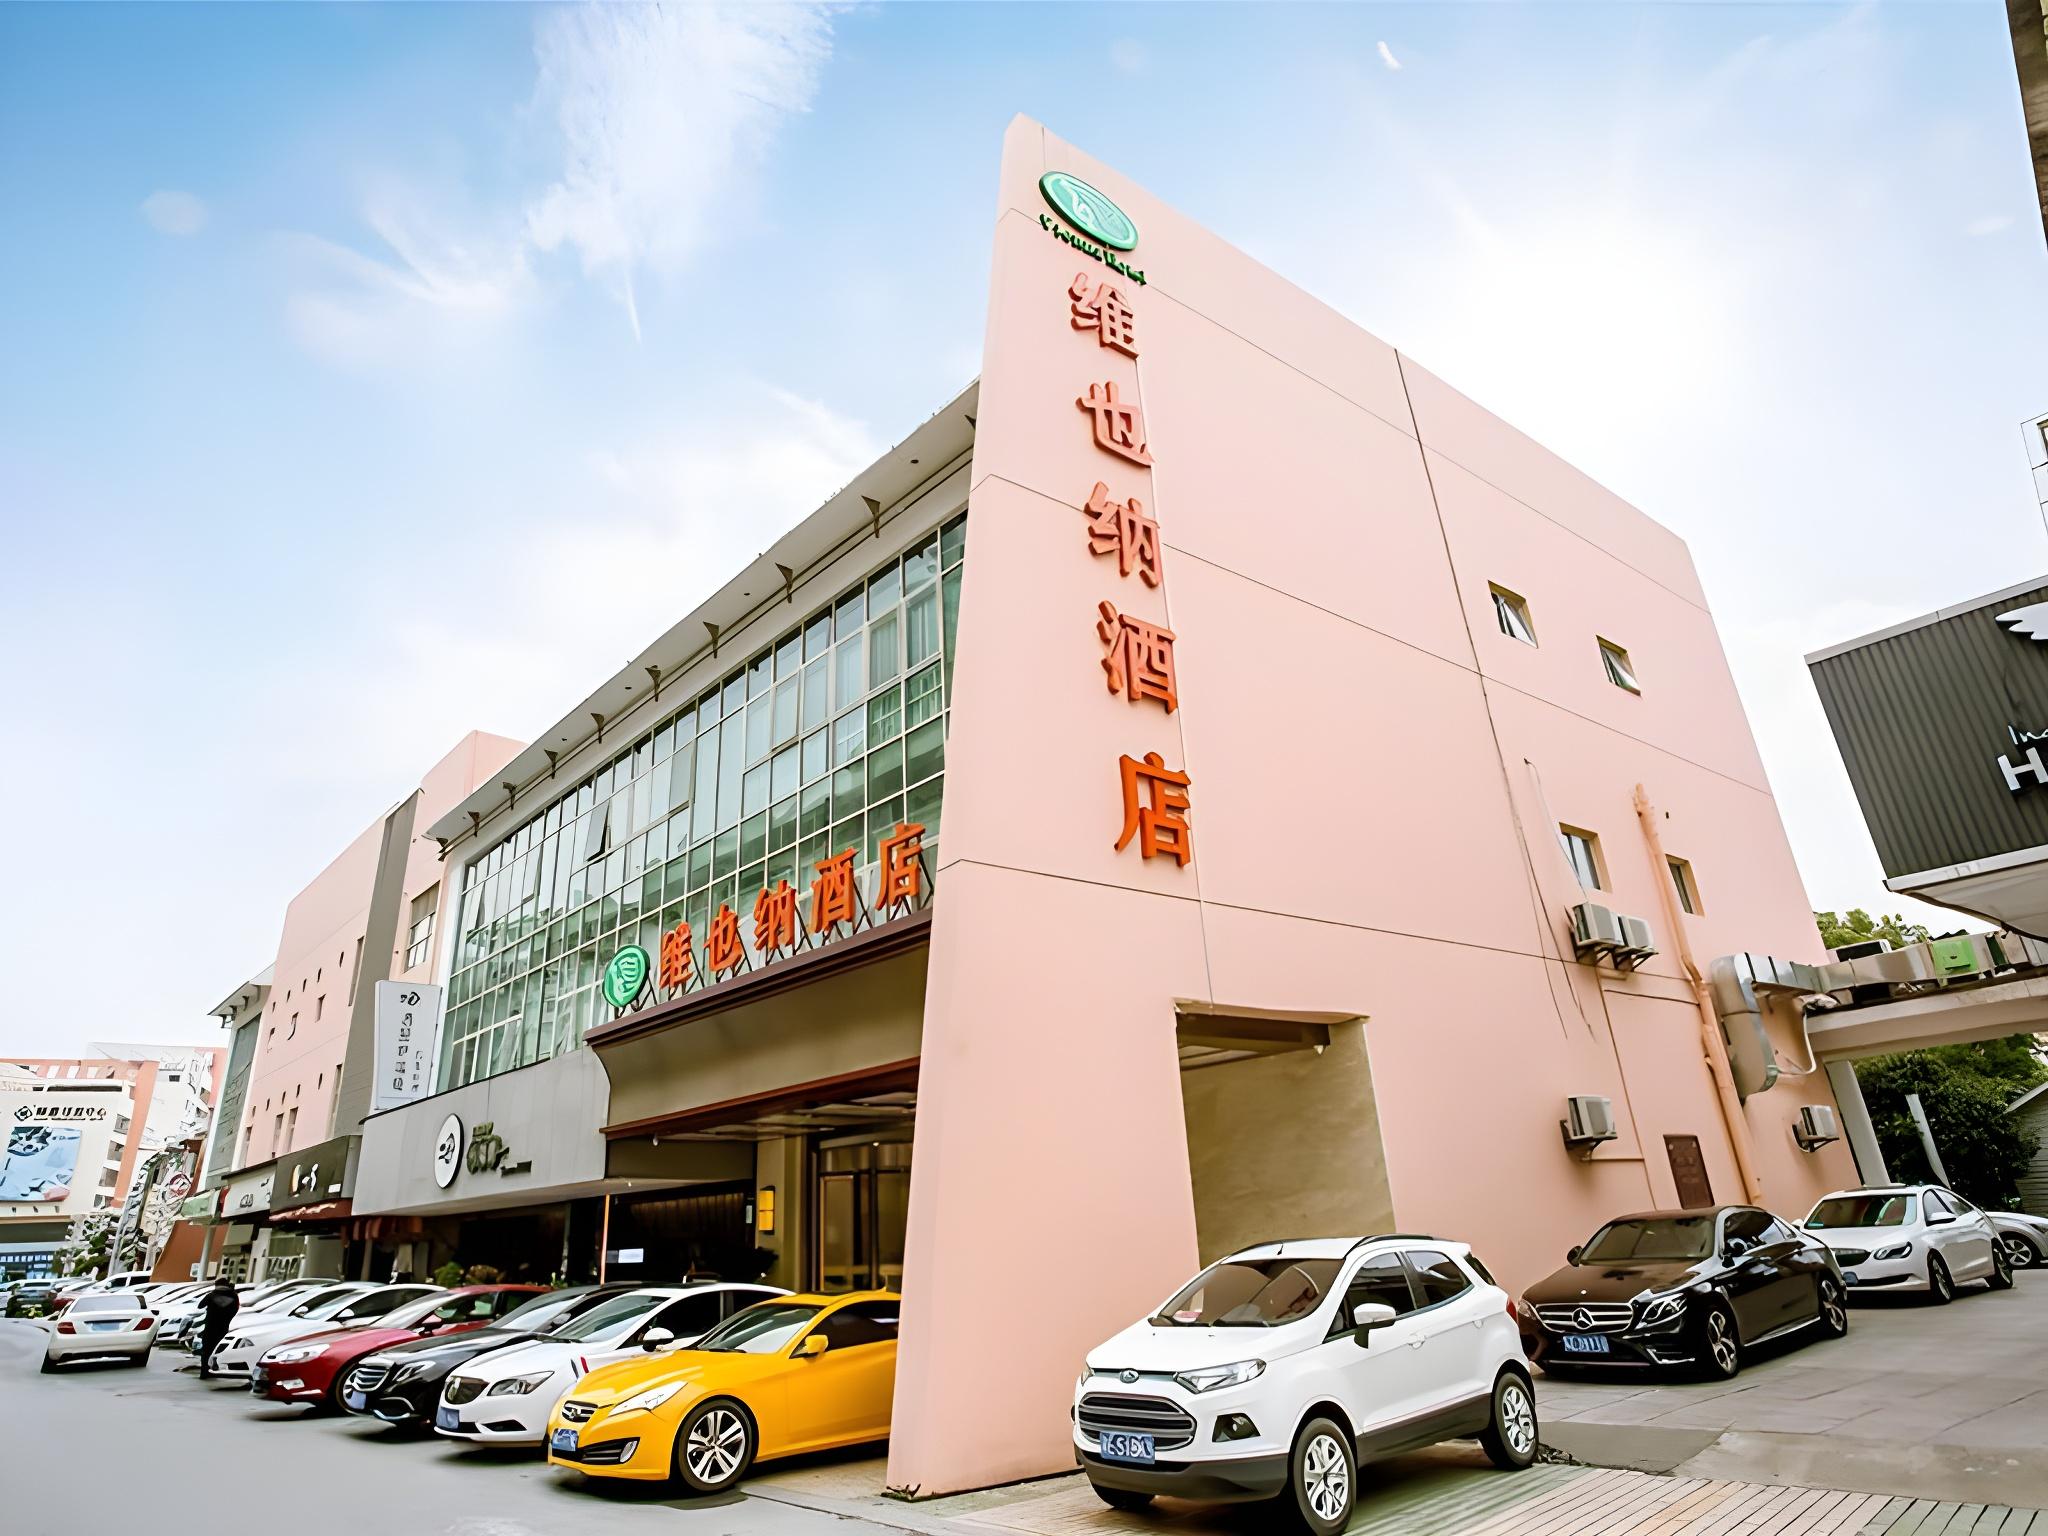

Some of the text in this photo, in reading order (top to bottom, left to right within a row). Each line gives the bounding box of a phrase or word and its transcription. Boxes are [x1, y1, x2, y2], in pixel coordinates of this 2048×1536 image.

[1068, 272, 1192, 868] 维也纳酒店
[659, 822, 927, 990] 维也纳酒店
